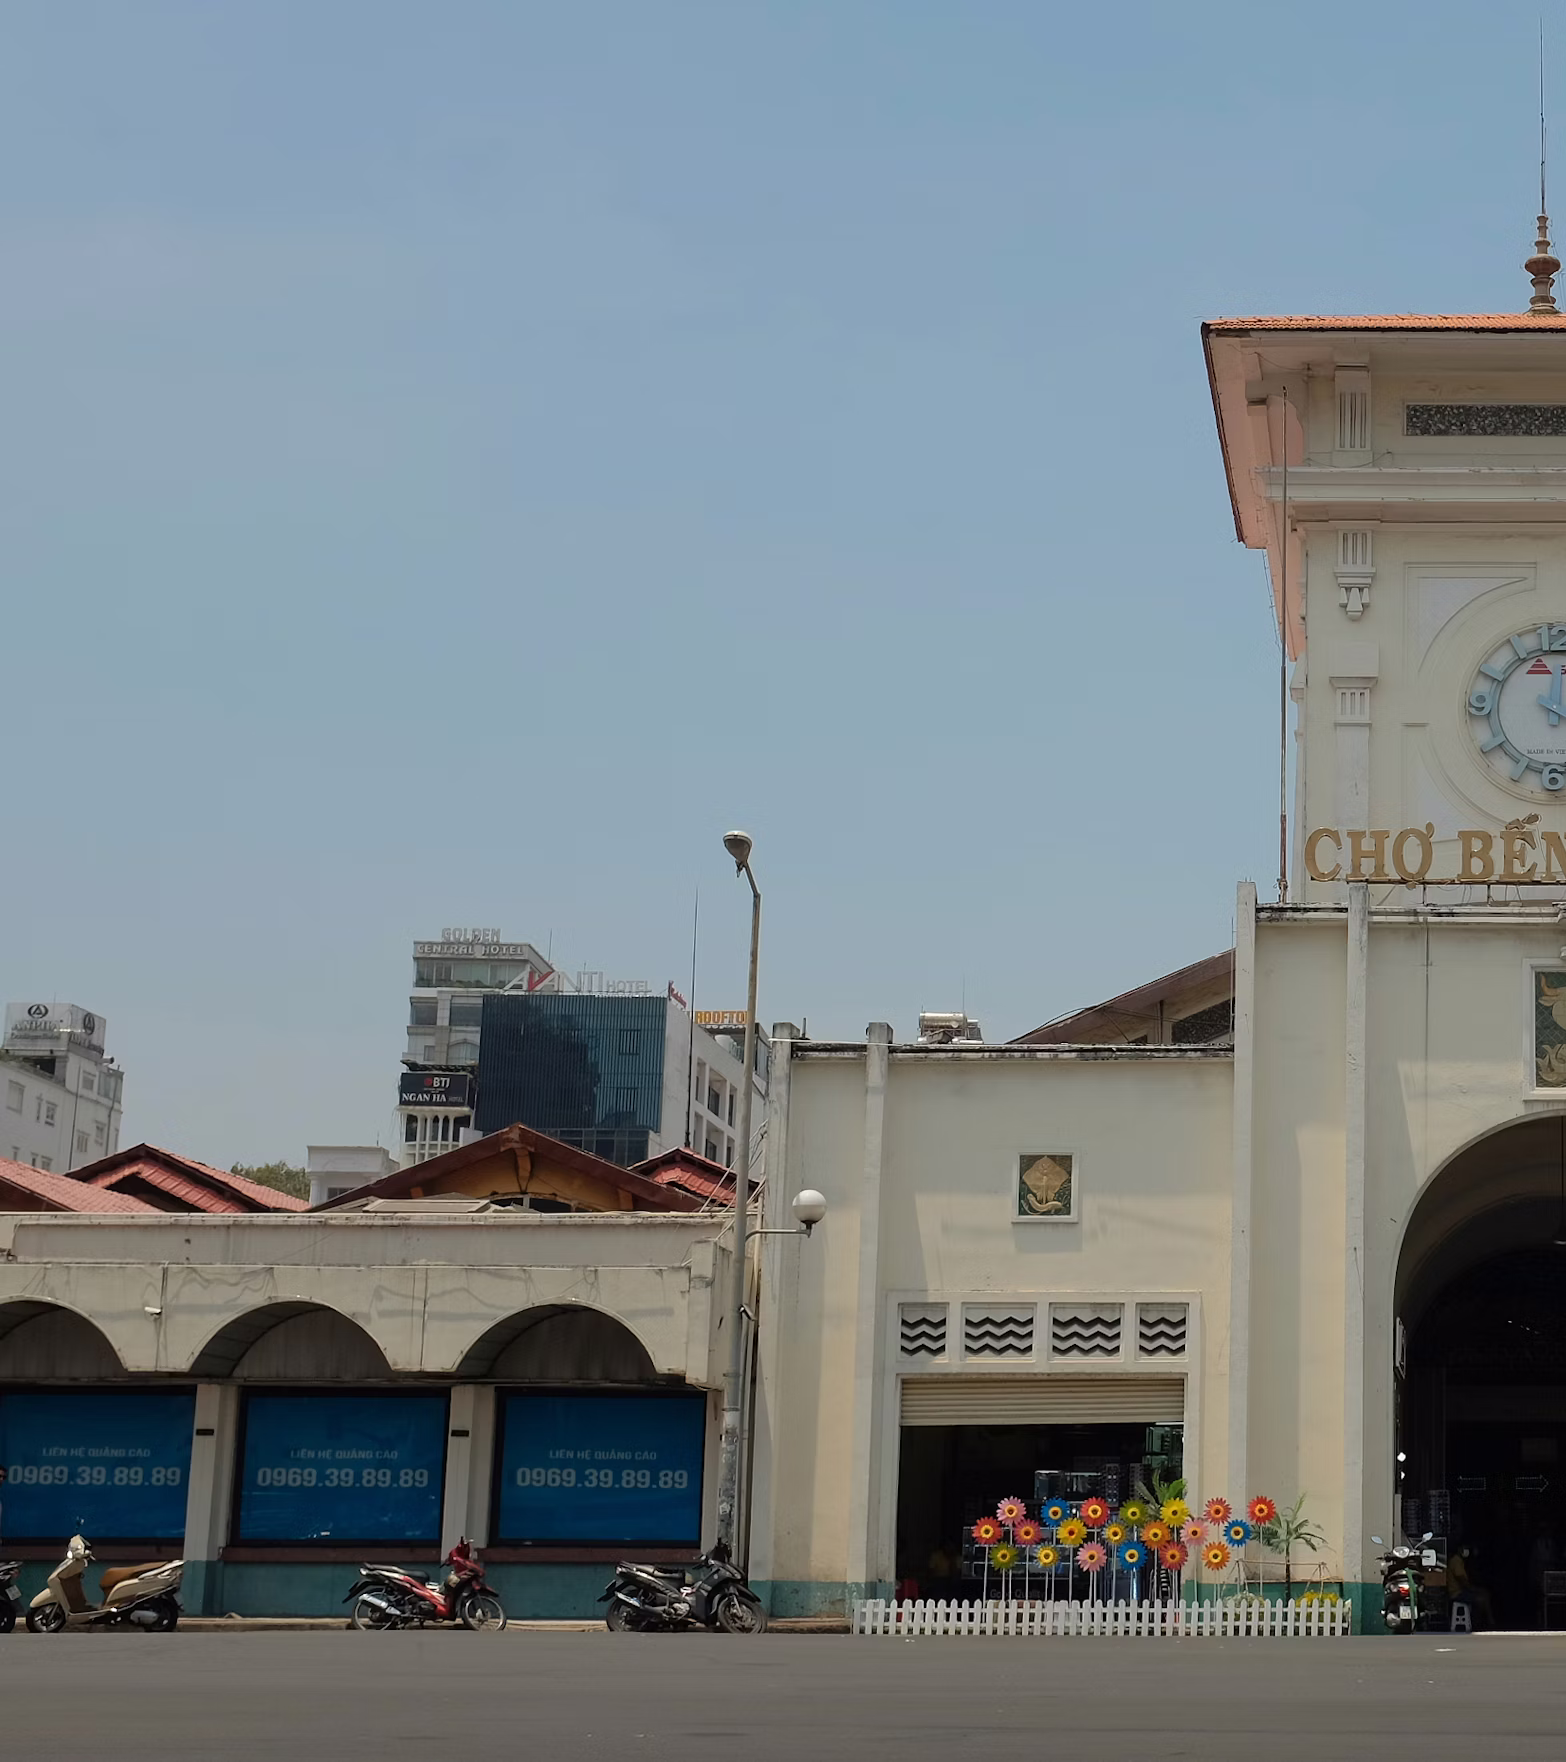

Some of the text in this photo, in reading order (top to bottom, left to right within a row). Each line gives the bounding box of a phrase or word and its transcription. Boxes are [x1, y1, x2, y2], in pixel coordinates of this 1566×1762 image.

[1469, 691, 1493, 716] 9
[1541, 764, 1566, 791] 6
[1304, 821, 1434, 891] CHỢ
[441, 927, 502, 944] GOLDEN
[416, 943, 525, 956] CENTRAL HOTEL
[502, 966, 652, 993] AVANTI HOTEL
[695, 1011, 748, 1024] ROOFTO
[402, 1092, 431, 1102] NGAN
[432, 1093, 447, 1102] HA
[8, 1465, 181, 1486] 0969.39.89.89
[257, 1467, 429, 1487] 0969.39.89.89
[516, 1467, 688, 1489] 0969.39.89.89
